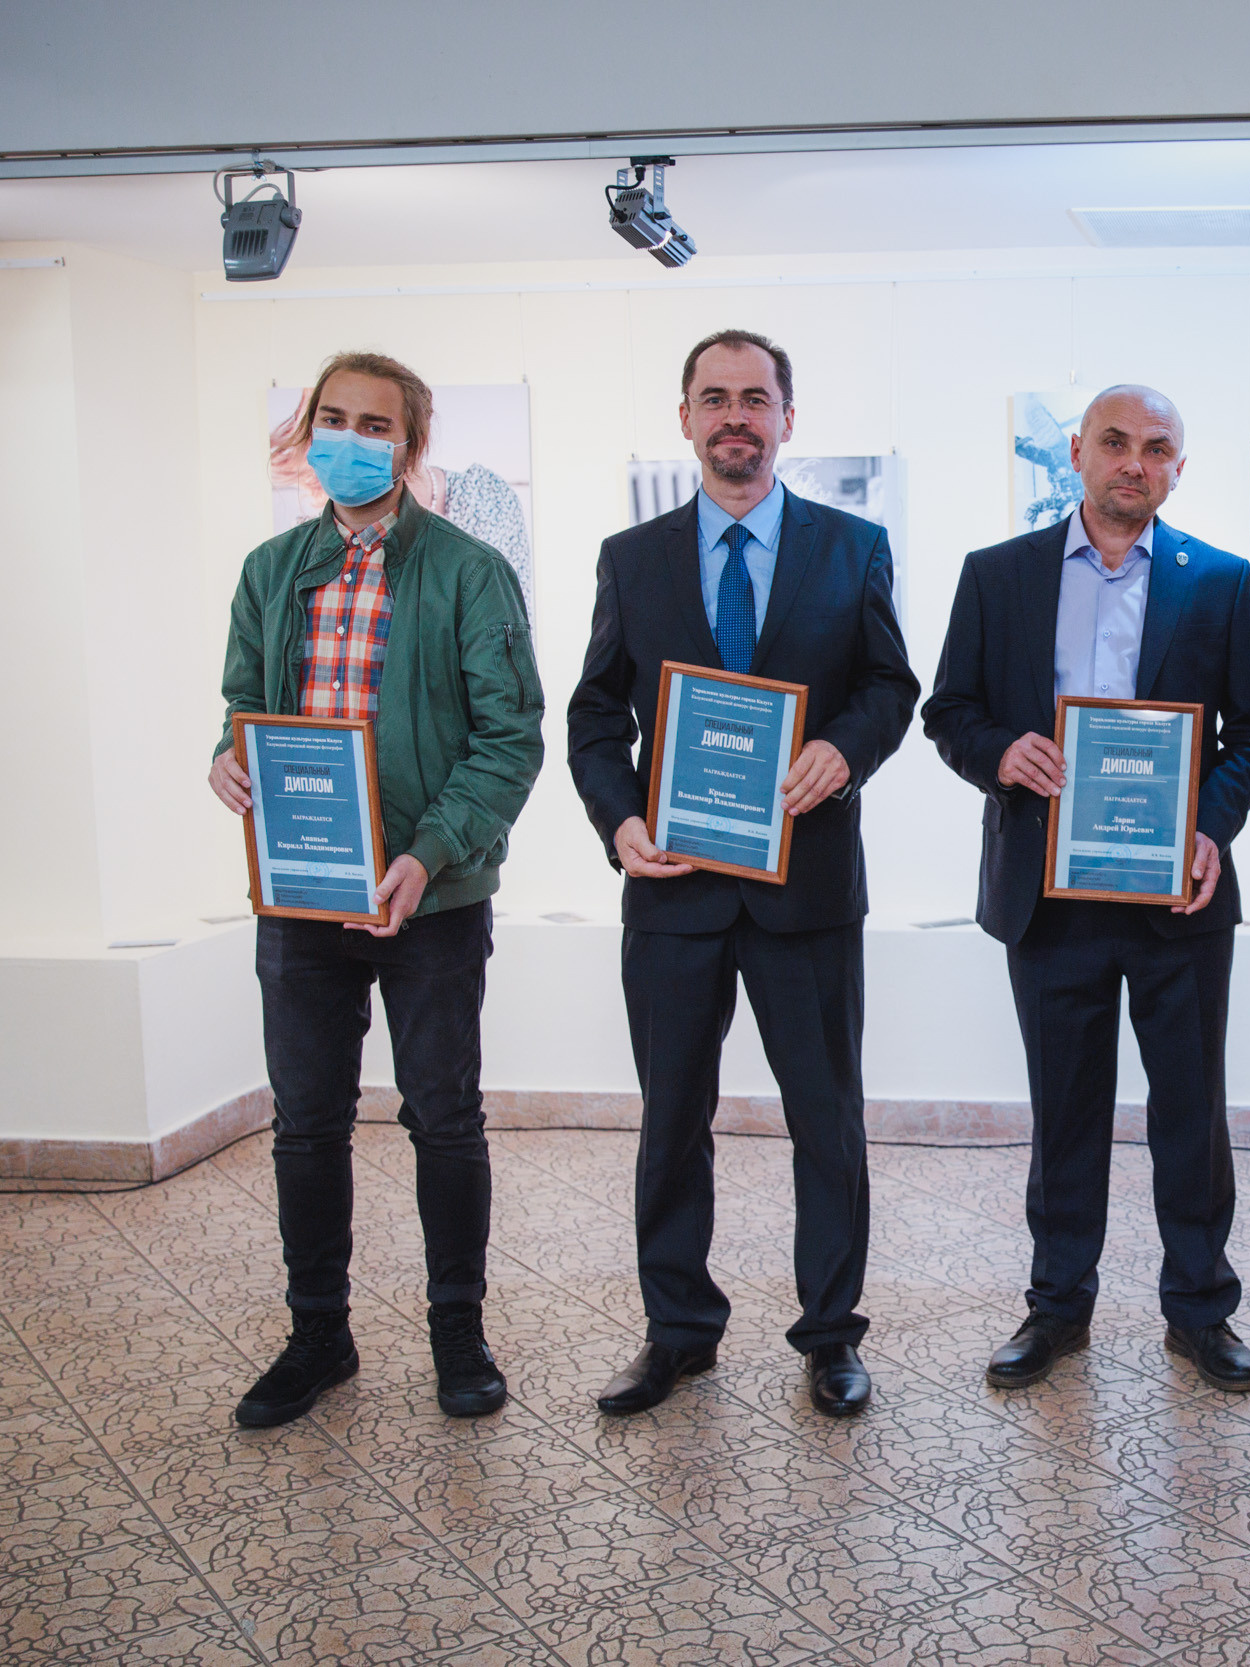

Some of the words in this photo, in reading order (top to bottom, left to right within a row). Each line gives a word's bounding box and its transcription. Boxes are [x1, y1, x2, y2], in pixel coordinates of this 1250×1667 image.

[705, 719, 753, 735] СПЕЦИАЛЬНЫЙ
[701, 730, 754, 753] ДИПЛОМ
[1104, 747, 1152, 758] СПЕЦИАЛЬНЫЙ
[284, 765, 330, 775] СПЕЦИАЛЬНЫЙ
[1101, 758, 1153, 775] ДИПЛОМ
[704, 768, 746, 780] НАГРАЖДАЕТСЯ
[284, 776, 333, 793] ДИПЛОМ
[709, 788, 736, 799] Крылов
[678, 791, 713, 804] Владимир
[714, 798, 765, 813] Владимирович
[1112, 816, 1135, 824] Ларин
[1093, 824, 1118, 832] Андрей
[1121, 825, 1154, 834] Юрьевич
[300, 835, 328, 843] Ананьев
[277, 842, 303, 850] Кирилл
[305, 843, 353, 853] Владимирович
